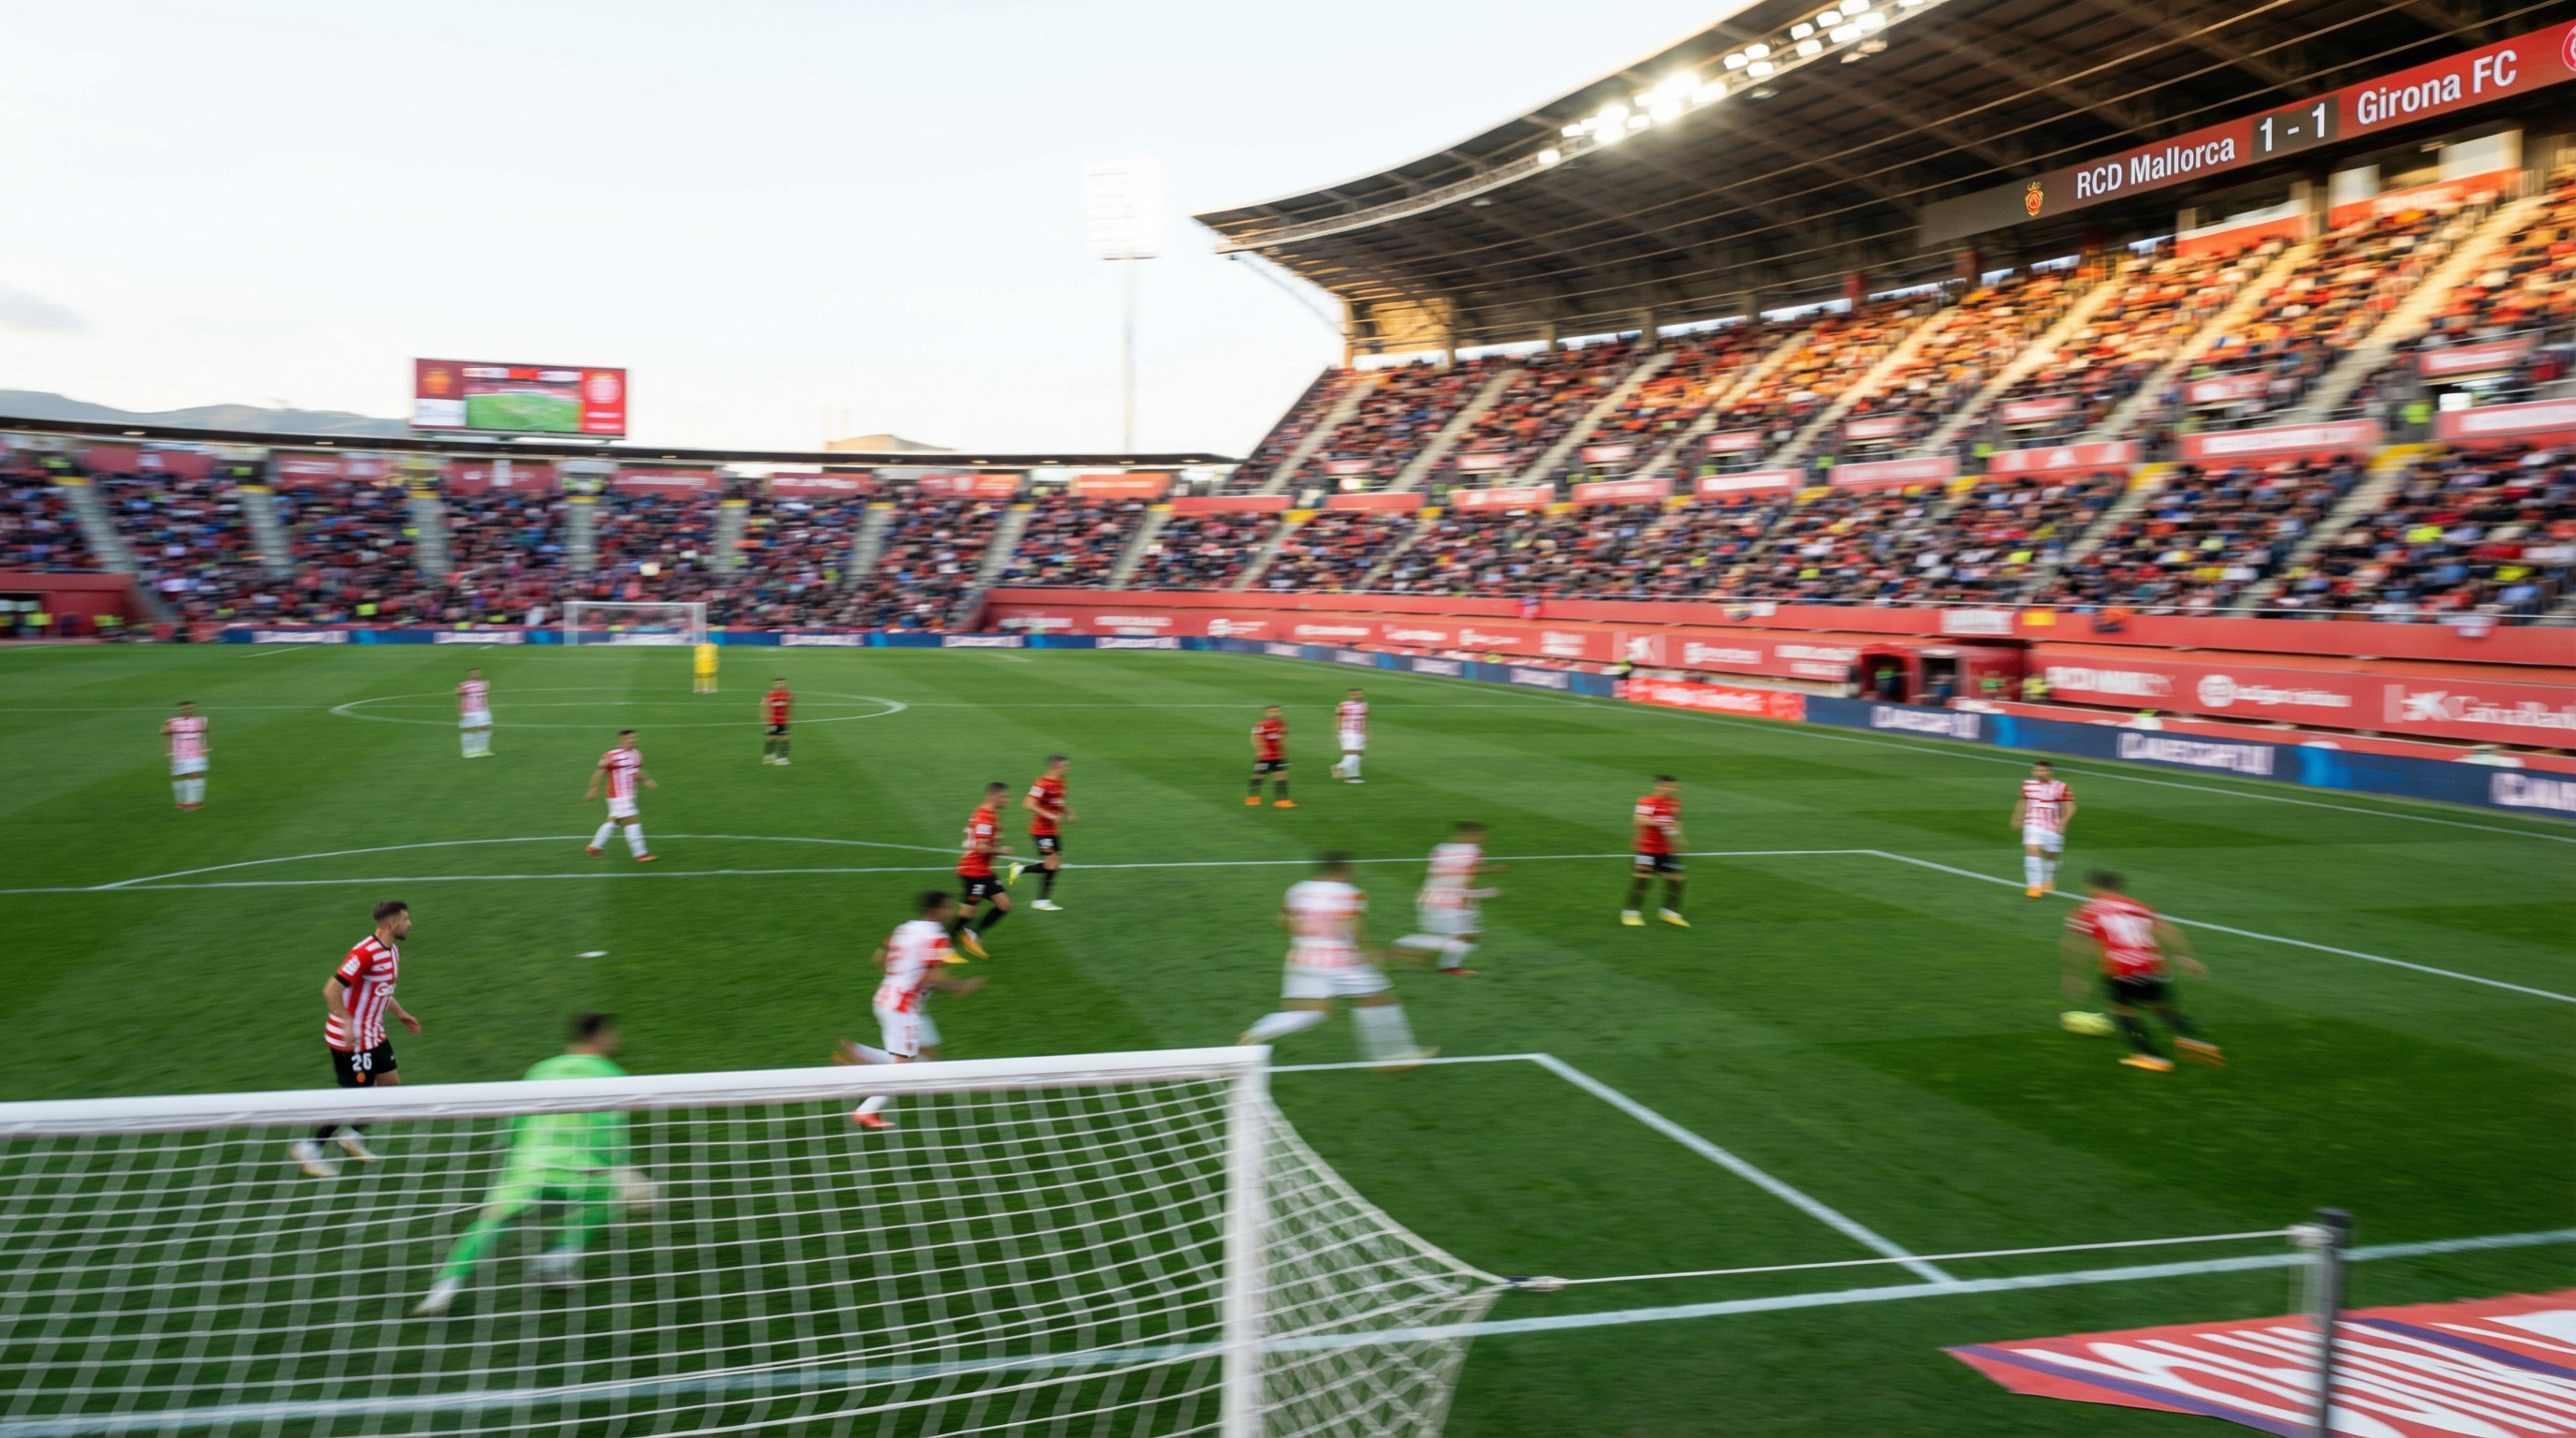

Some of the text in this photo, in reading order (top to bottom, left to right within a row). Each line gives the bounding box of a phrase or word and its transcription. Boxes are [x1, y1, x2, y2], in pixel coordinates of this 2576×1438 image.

[2076, 163, 2122, 199] RCD
[2130, 138, 2235, 185] Mallorca
[2260, 117, 2273, 152] 1
[2312, 103, 2325, 138] 1
[2357, 73, 2462, 125] Girona
[2473, 50, 2518, 94] FC
